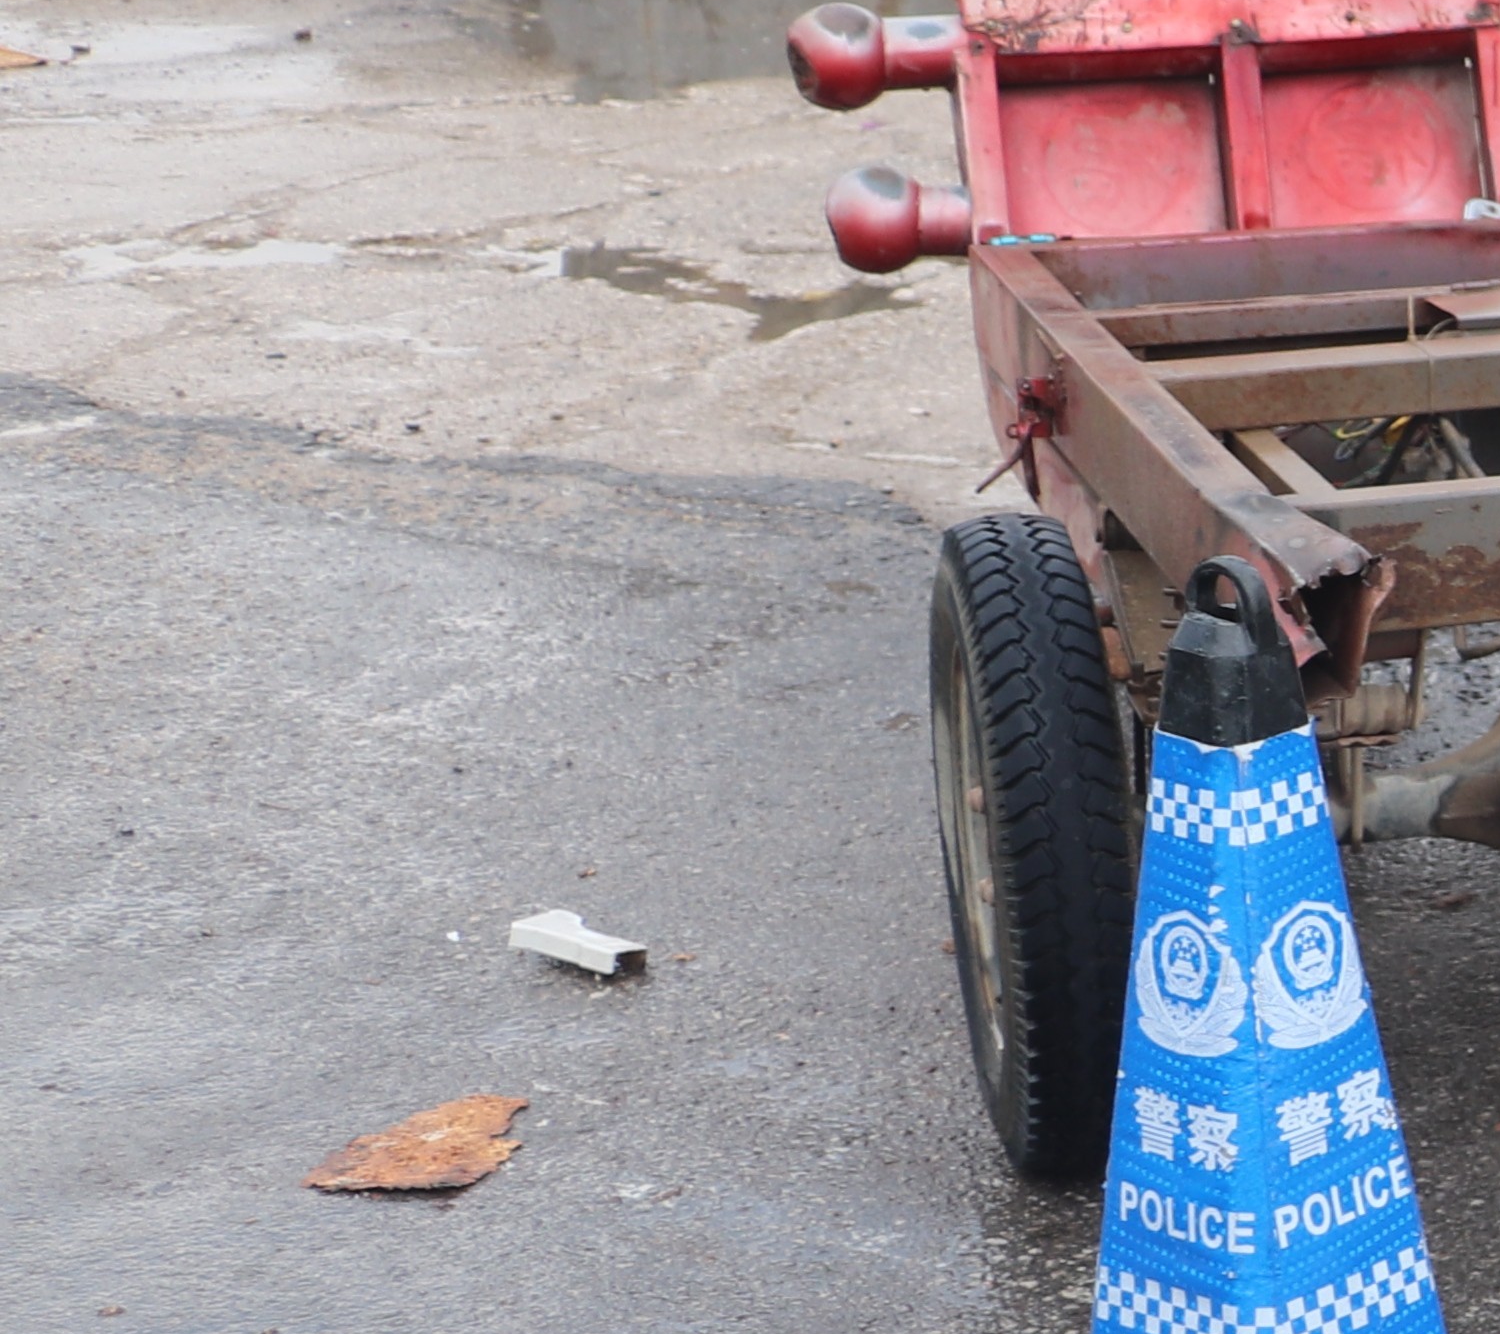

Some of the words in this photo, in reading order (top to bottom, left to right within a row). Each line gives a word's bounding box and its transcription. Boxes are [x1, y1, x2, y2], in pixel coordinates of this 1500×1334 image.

[1133, 1086, 1239, 1173] 警察
[1275, 1068, 1397, 1166] 警察
[1119, 1181, 1256, 1255] POLICE
[1273, 1155, 1412, 1250] POLICE
